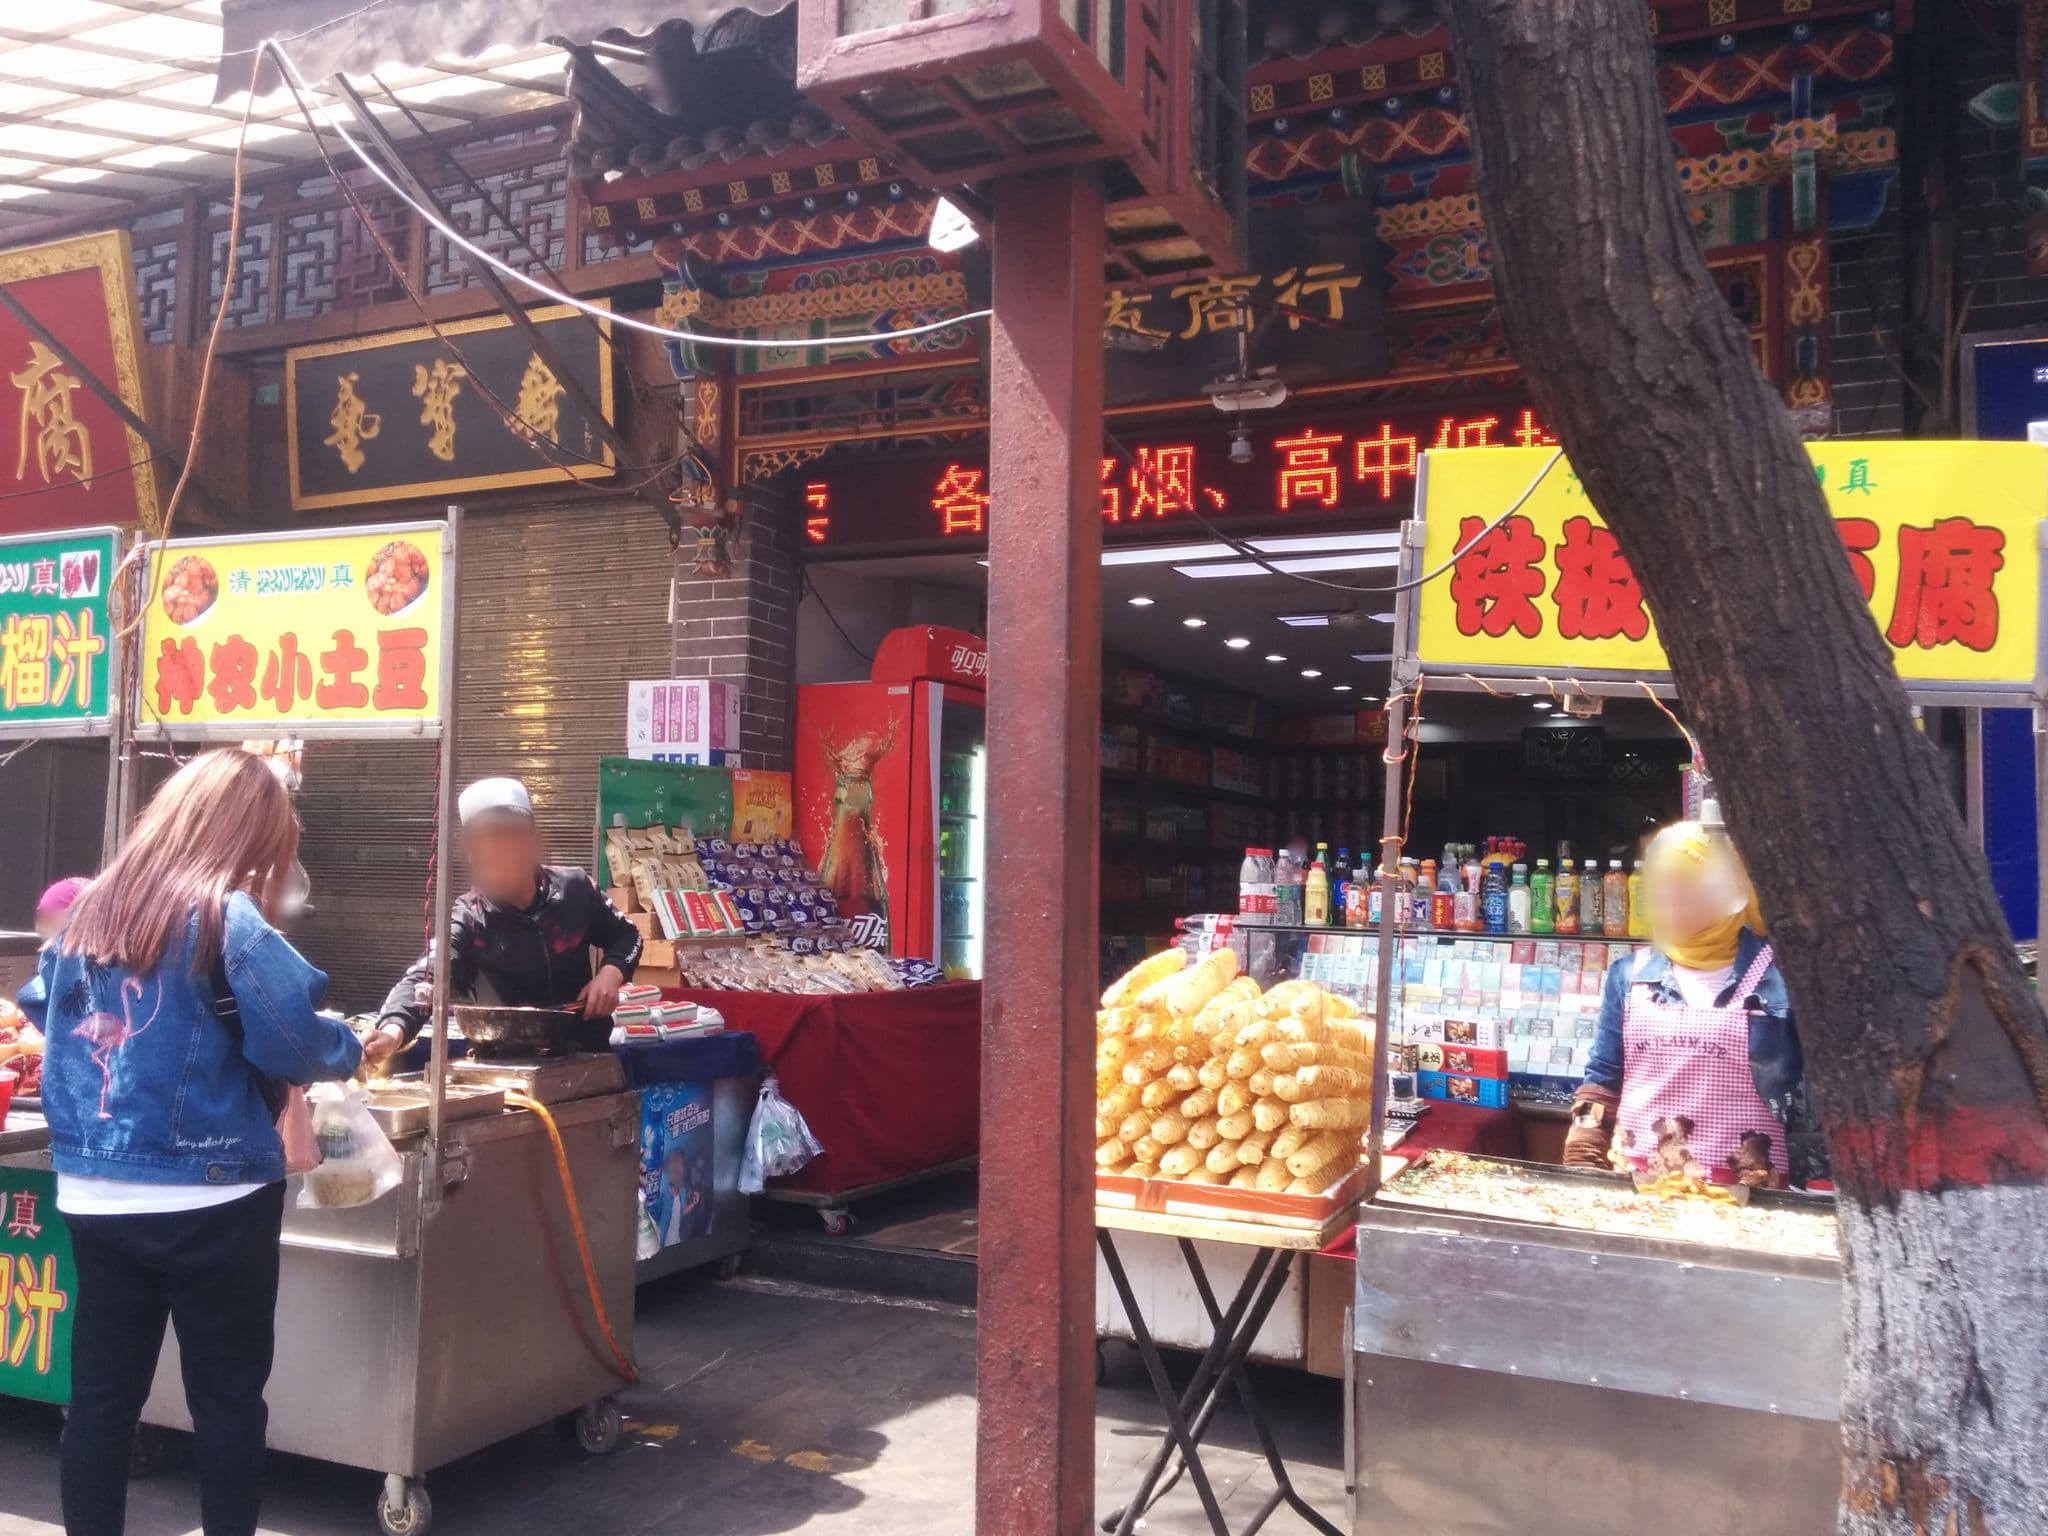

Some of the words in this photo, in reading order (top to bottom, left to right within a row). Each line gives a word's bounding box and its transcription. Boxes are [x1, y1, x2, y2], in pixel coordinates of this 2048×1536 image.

[1840, 458, 1878, 494] 真
[30, 558, 60, 595] 真
[229, 569, 252, 593] 清
[329, 563, 353, 588] 真
[1451, 515, 2005, 653] 铁板腐
[7, 1190, 42, 1239] 真
